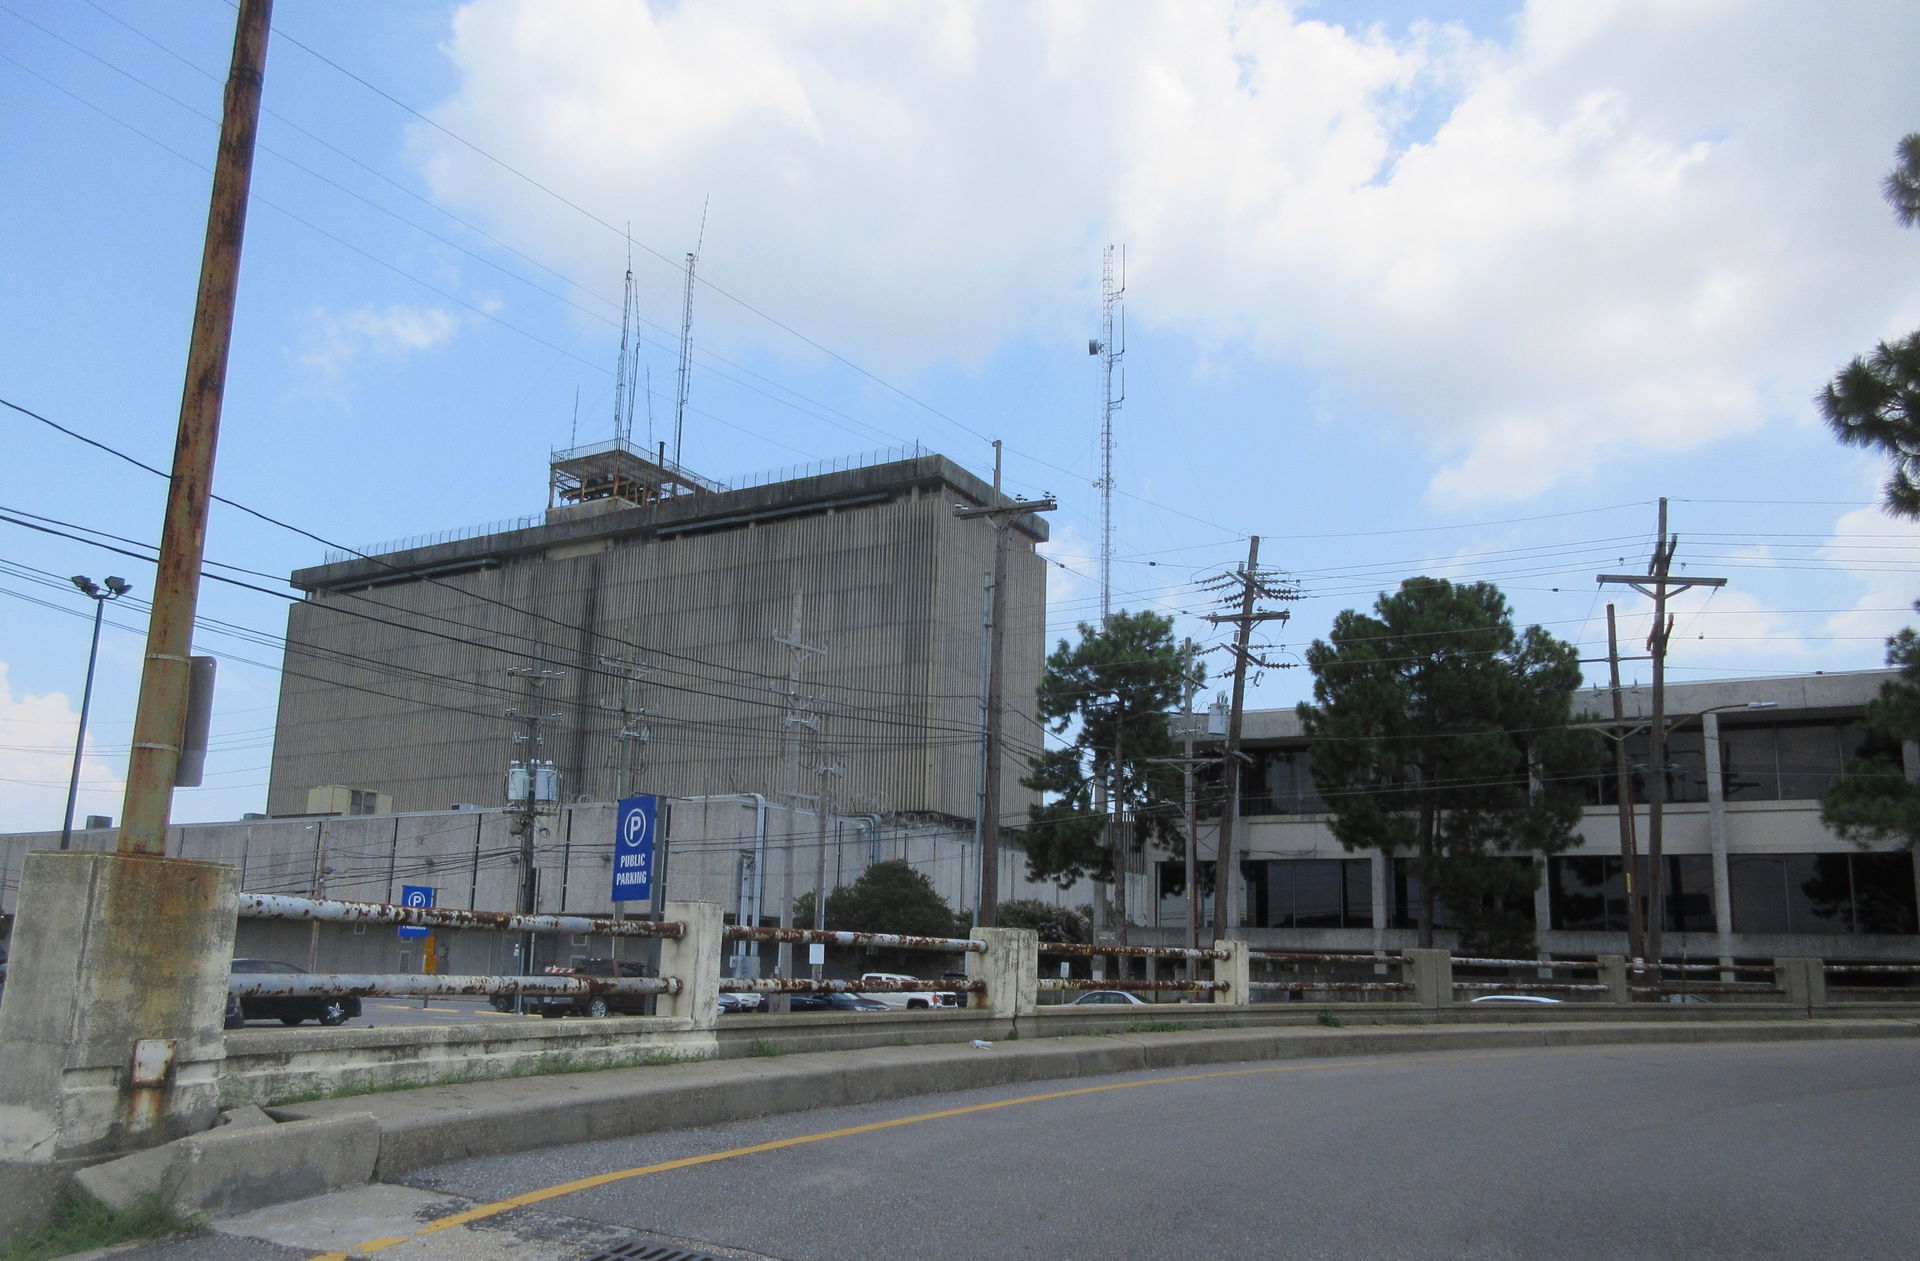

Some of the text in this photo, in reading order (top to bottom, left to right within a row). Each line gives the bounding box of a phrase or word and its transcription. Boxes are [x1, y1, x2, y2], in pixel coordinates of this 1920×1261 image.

[630, 816, 641, 839] P
[621, 853, 645, 867] PUBLIC
[616, 871, 646, 885] PARKING
[413, 895, 422, 907] P
